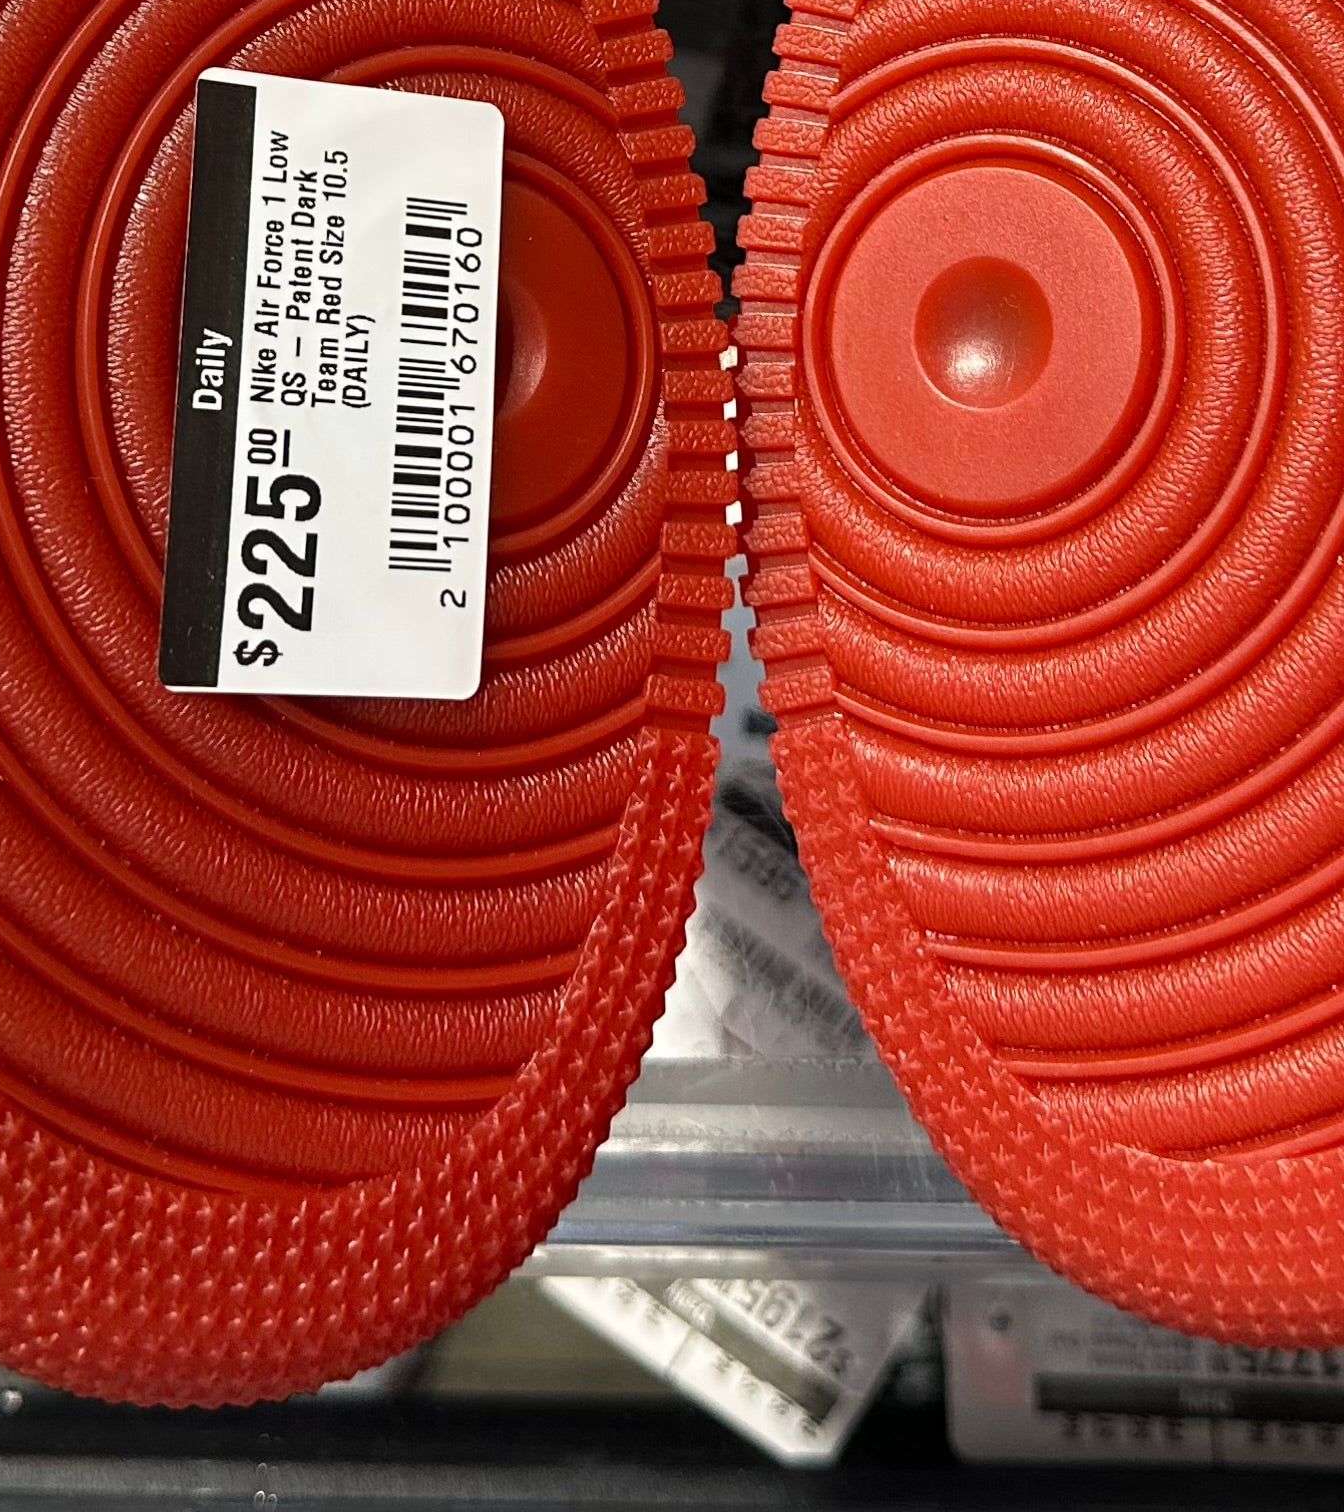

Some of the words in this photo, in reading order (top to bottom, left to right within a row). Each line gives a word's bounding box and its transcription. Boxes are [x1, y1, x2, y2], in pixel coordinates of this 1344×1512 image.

[263, 130, 290, 184] Low
[323, 150, 349, 201] 10.5
[261, 194, 286, 206] 1
[291, 169, 318, 228] Dark
[257, 219, 285, 289] Force
[319, 214, 346, 265] Size
[286, 238, 315, 322] Patent
[315, 275, 343, 326] Red
[254, 299, 281, 338] Air
[192, 328, 233, 411] Daily
[250, 348, 278, 403] Nike
[311, 338, 340, 408] Team
[342, 314, 376, 409] (DAILY)
[281, 372, 308, 406] QS
[247, 428, 278, 465] 00
[233, 473, 322, 667] $225
[439, 589, 467, 608] 2
